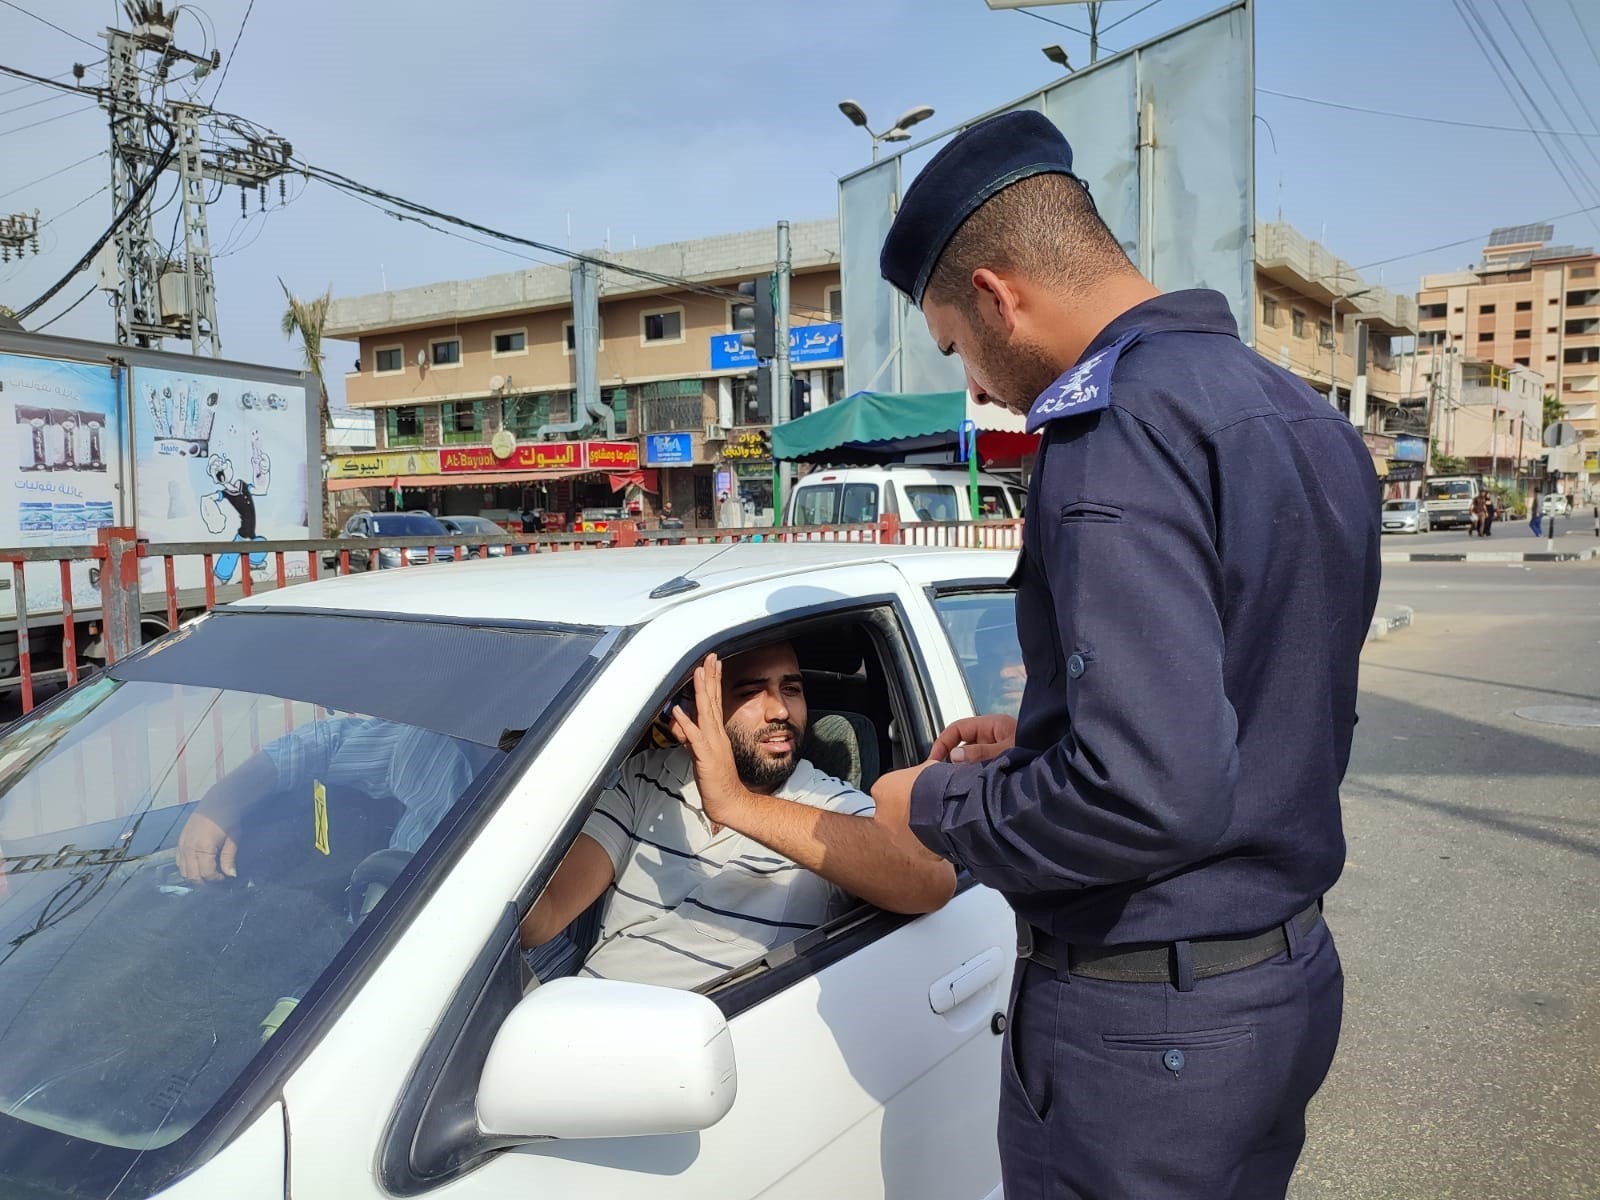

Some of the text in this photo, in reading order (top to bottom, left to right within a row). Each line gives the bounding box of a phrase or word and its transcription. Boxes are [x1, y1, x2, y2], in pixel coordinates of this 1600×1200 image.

[803, 331, 838, 349] مركز
[519, 445, 574, 468] البيوك
[616, 447, 637, 463] شاورما
[342, 458, 384, 475] البيوك
